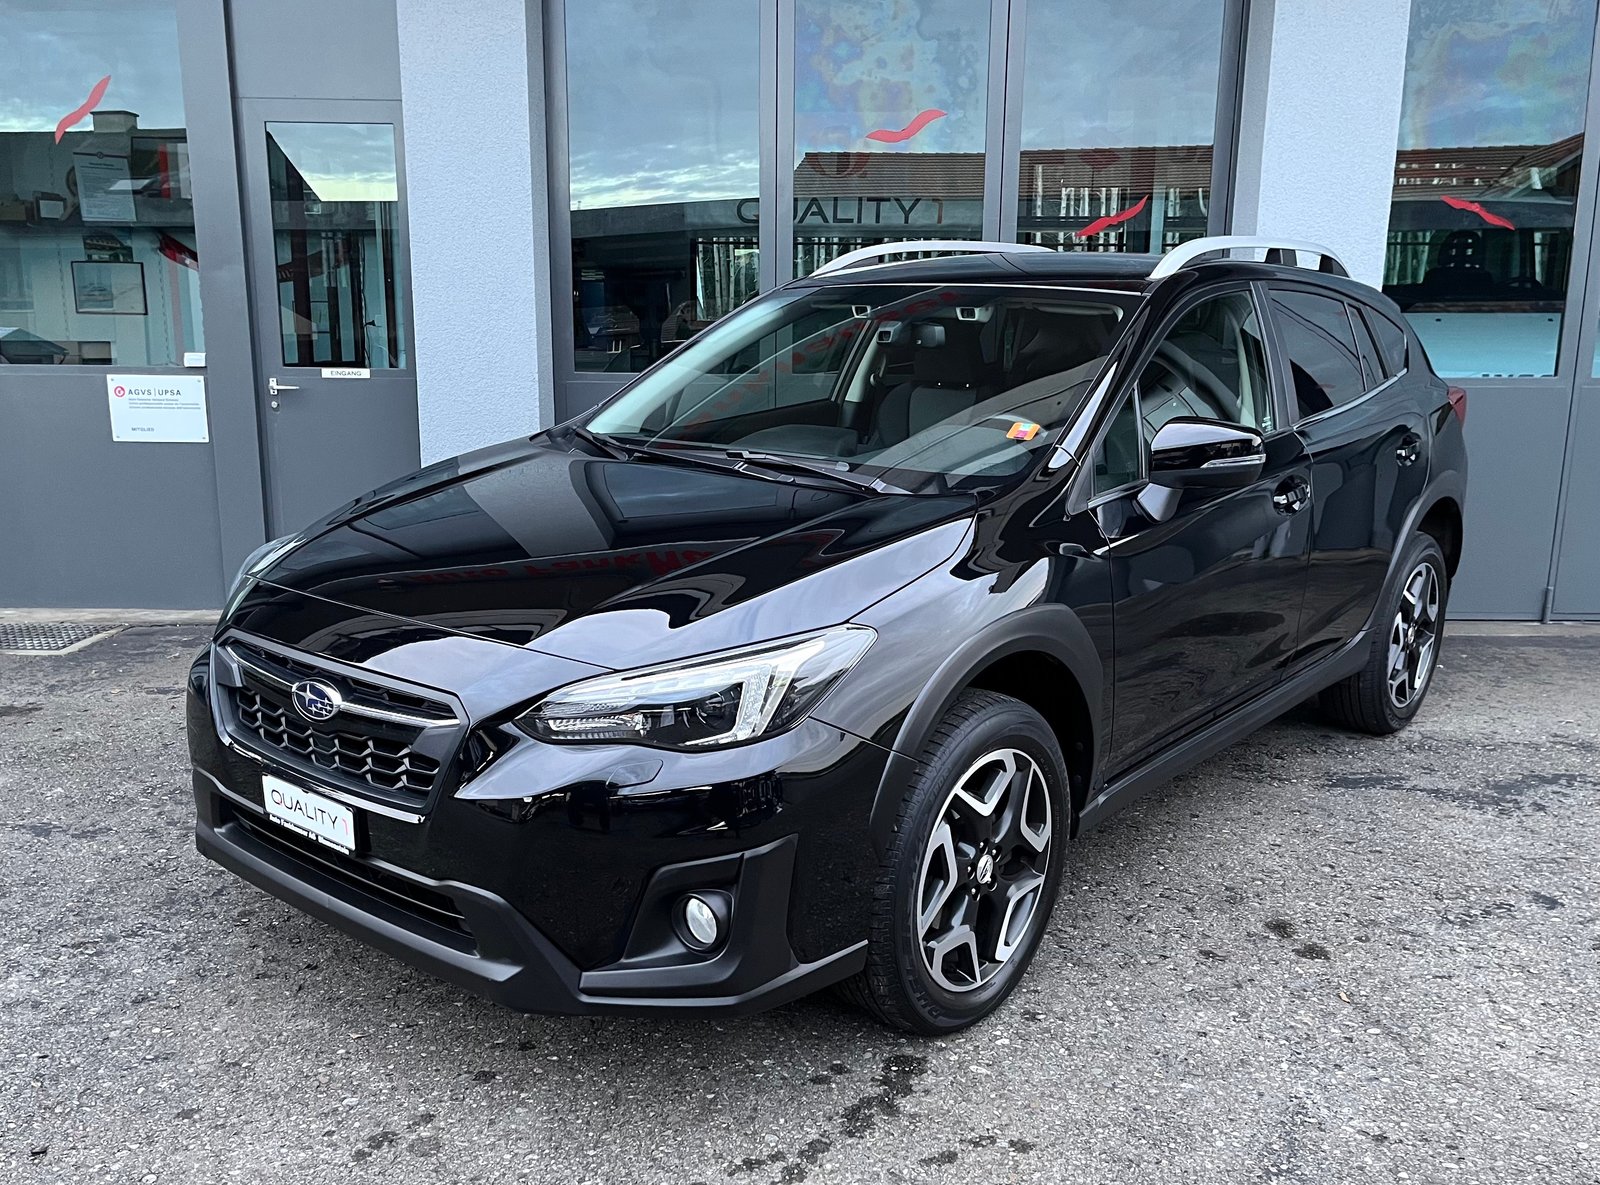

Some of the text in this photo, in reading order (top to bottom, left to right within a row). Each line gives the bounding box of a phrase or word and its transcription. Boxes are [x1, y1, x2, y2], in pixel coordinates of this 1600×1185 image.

[736, 197, 922, 224] QALITY
[128, 388, 152, 396] AGVS
[271, 789, 338, 829] QUALITY
